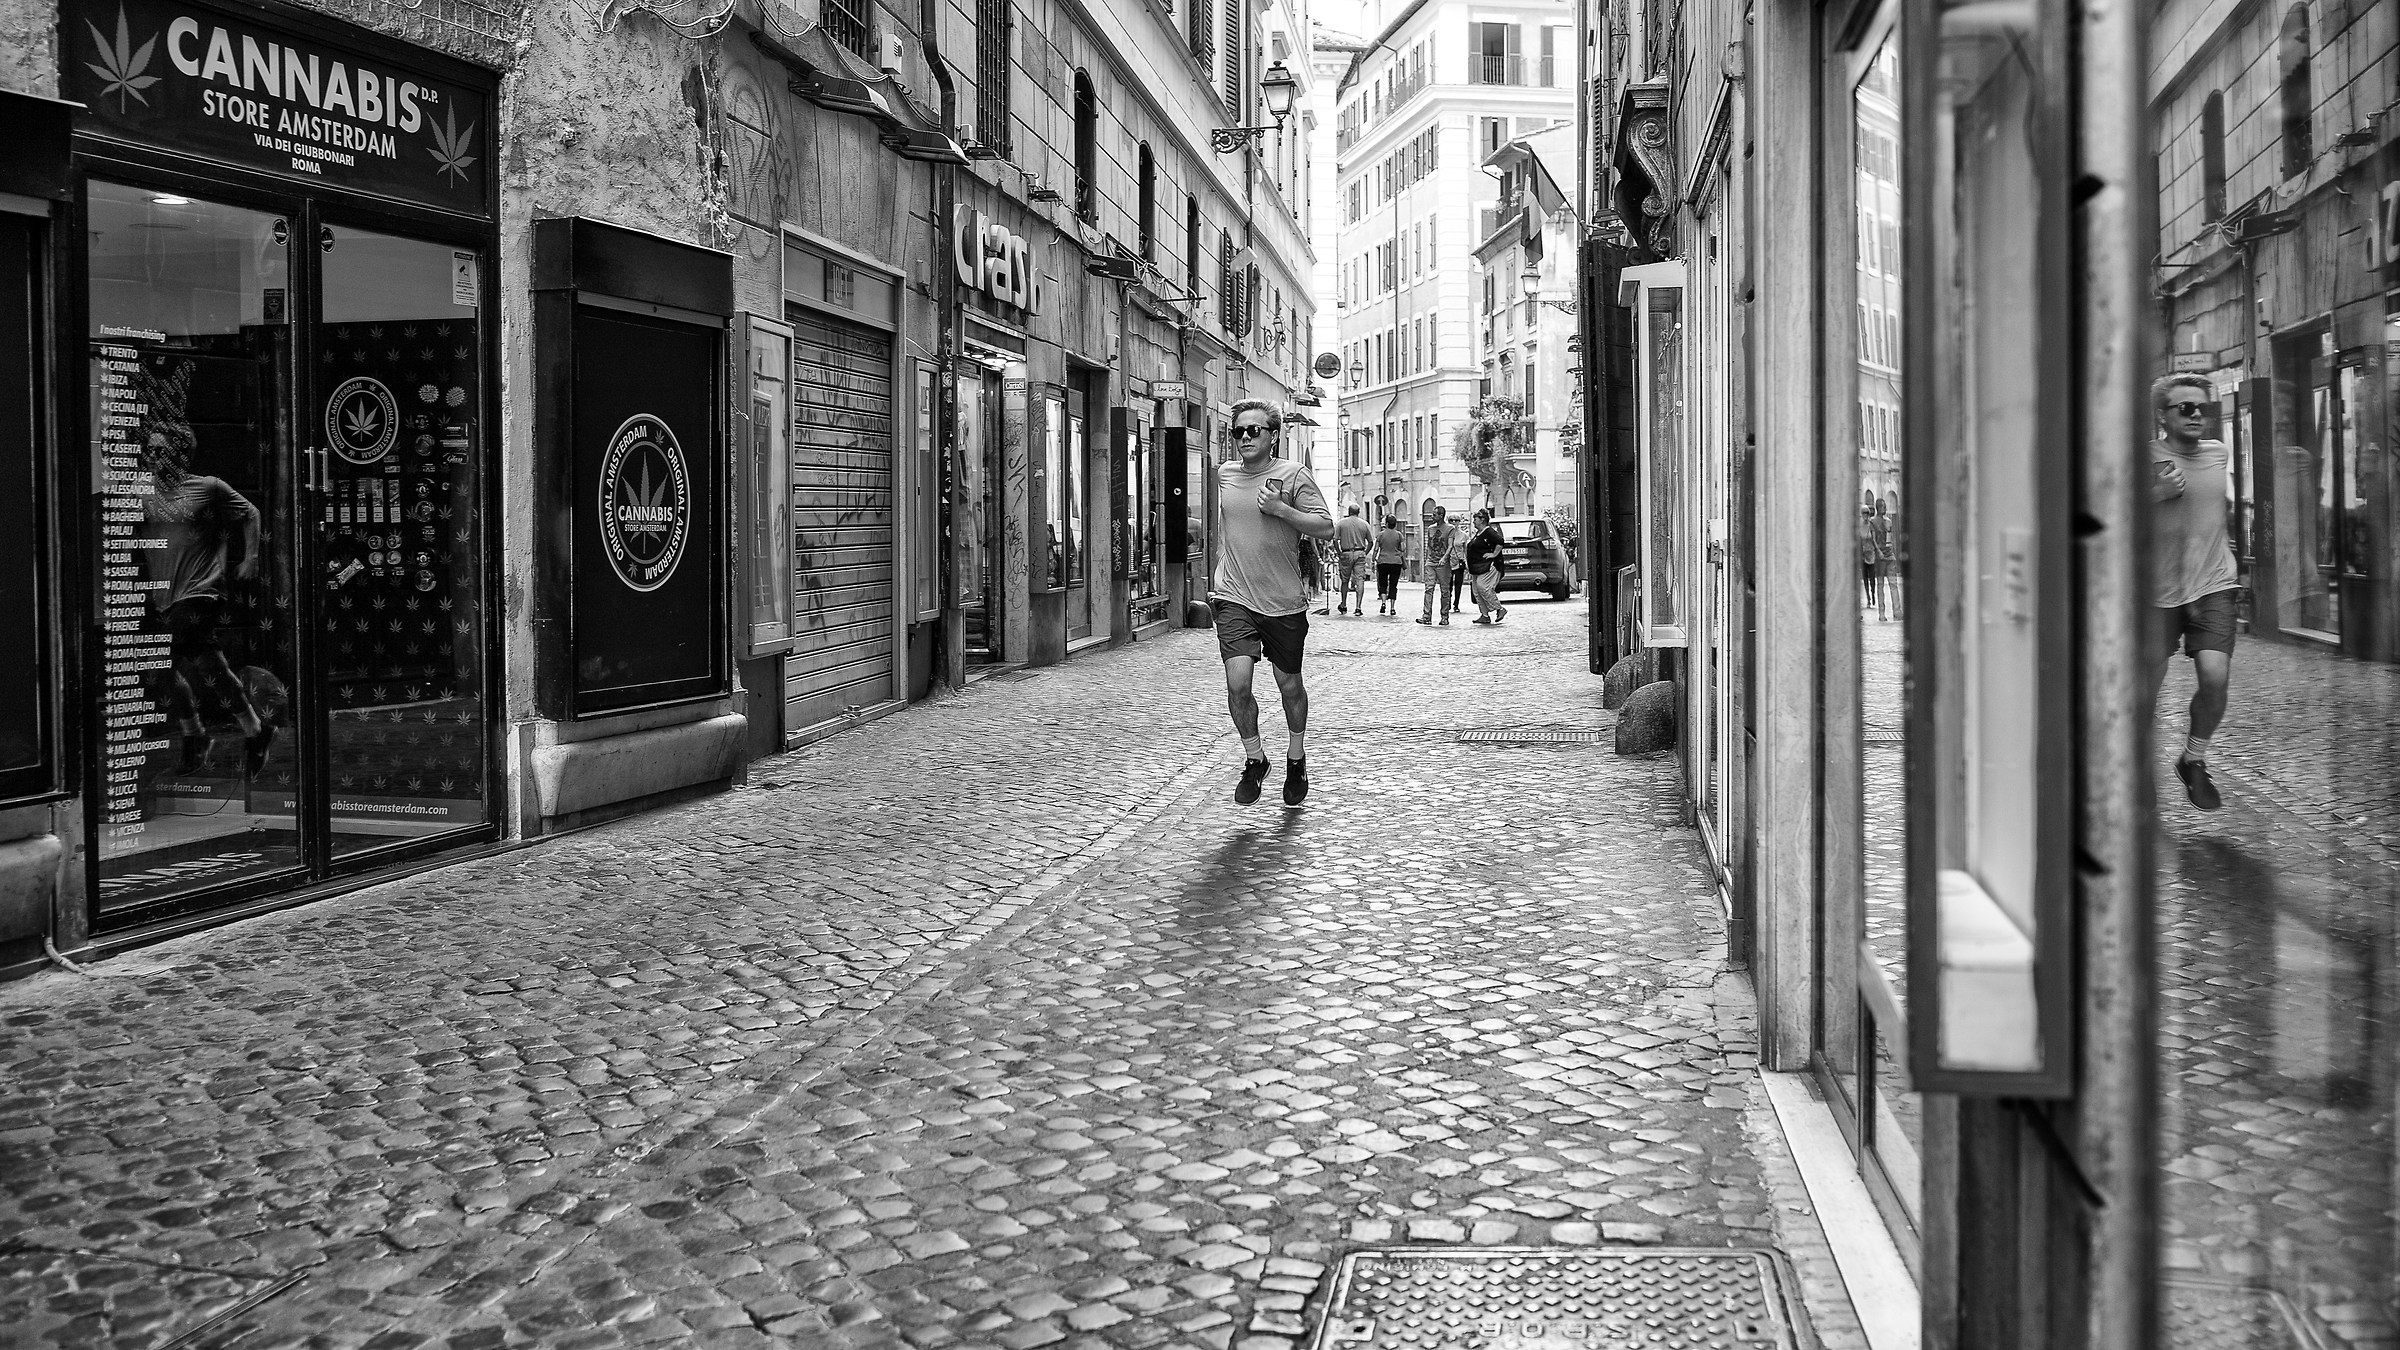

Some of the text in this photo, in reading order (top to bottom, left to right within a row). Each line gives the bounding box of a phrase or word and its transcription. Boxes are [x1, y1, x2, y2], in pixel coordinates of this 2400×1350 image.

[167, 16, 423, 135] CANNABIS
[203, 89, 397, 160] STORE AMSTERDAM
[253, 133, 355, 167] VIA DEI GIUBBONARI
[291, 157, 322, 175] ROMA
[104, 326, 126, 337] nostri
[126, 327, 166, 343] franchising
[108, 347, 138, 359] TRENTO
[108, 360, 140, 373] CATANIA
[108, 374, 128, 386] IBIZA
[108, 388, 137, 400] NAPOLI
[331, 382, 362, 416] AMSTERDAM
[108, 402, 136, 412] CECINA
[379, 392, 394, 425] ORIGINAL
[109, 416, 140, 426] VENEZIA
[109, 429, 126, 440] PISA
[330, 416, 345, 449] ORIGINAL
[109, 444, 142, 454] CASERTA
[361, 427, 393, 459] AMSTERDAM
[606, 426, 647, 484] AMSTERDAM
[109, 457, 138, 468] CESENA
[110, 470, 138, 481] SCIACCA
[667, 447, 685, 514] ORIGINAL
[109, 484, 155, 495] ALESSANDRIA
[110, 498, 143, 508] MARSALA
[110, 512, 145, 522] BAGHERIA
[618, 505, 673, 522] CANNABIS
[110, 526, 134, 536] PALAU
[604, 491, 624, 560] ORIGINAL
[624, 524, 666, 532] STORE AMSTERDAM
[645, 514, 684, 580] AMSTERDAM
[110, 552, 132, 563] OLBIA
[110, 566, 140, 577] SASSARI
[110, 581, 133, 591] ROMA
[110, 593, 146, 604] SARONNO
[111, 607, 146, 618] BOLOGNA
[112, 620, 141, 632] FIRENZE
[112, 634, 134, 646] ROMA
[112, 648, 134, 659] ROMA
[112, 662, 134, 672] ROMA
[113, 674, 140, 686] TORINO
[113, 688, 145, 700] CAGLIARI
[113, 702, 143, 714] VENARIA
[113, 714, 155, 728] MONCALIERI
[114, 728, 142, 742] MILANO
[114, 742, 142, 755] MILANO
[114, 755, 146, 769] SALERNO
[114, 770, 138, 782] BIELLA
[115, 784, 138, 796] LUCCA
[114, 797, 136, 810] SIENA
[116, 810, 142, 824] VARESE
